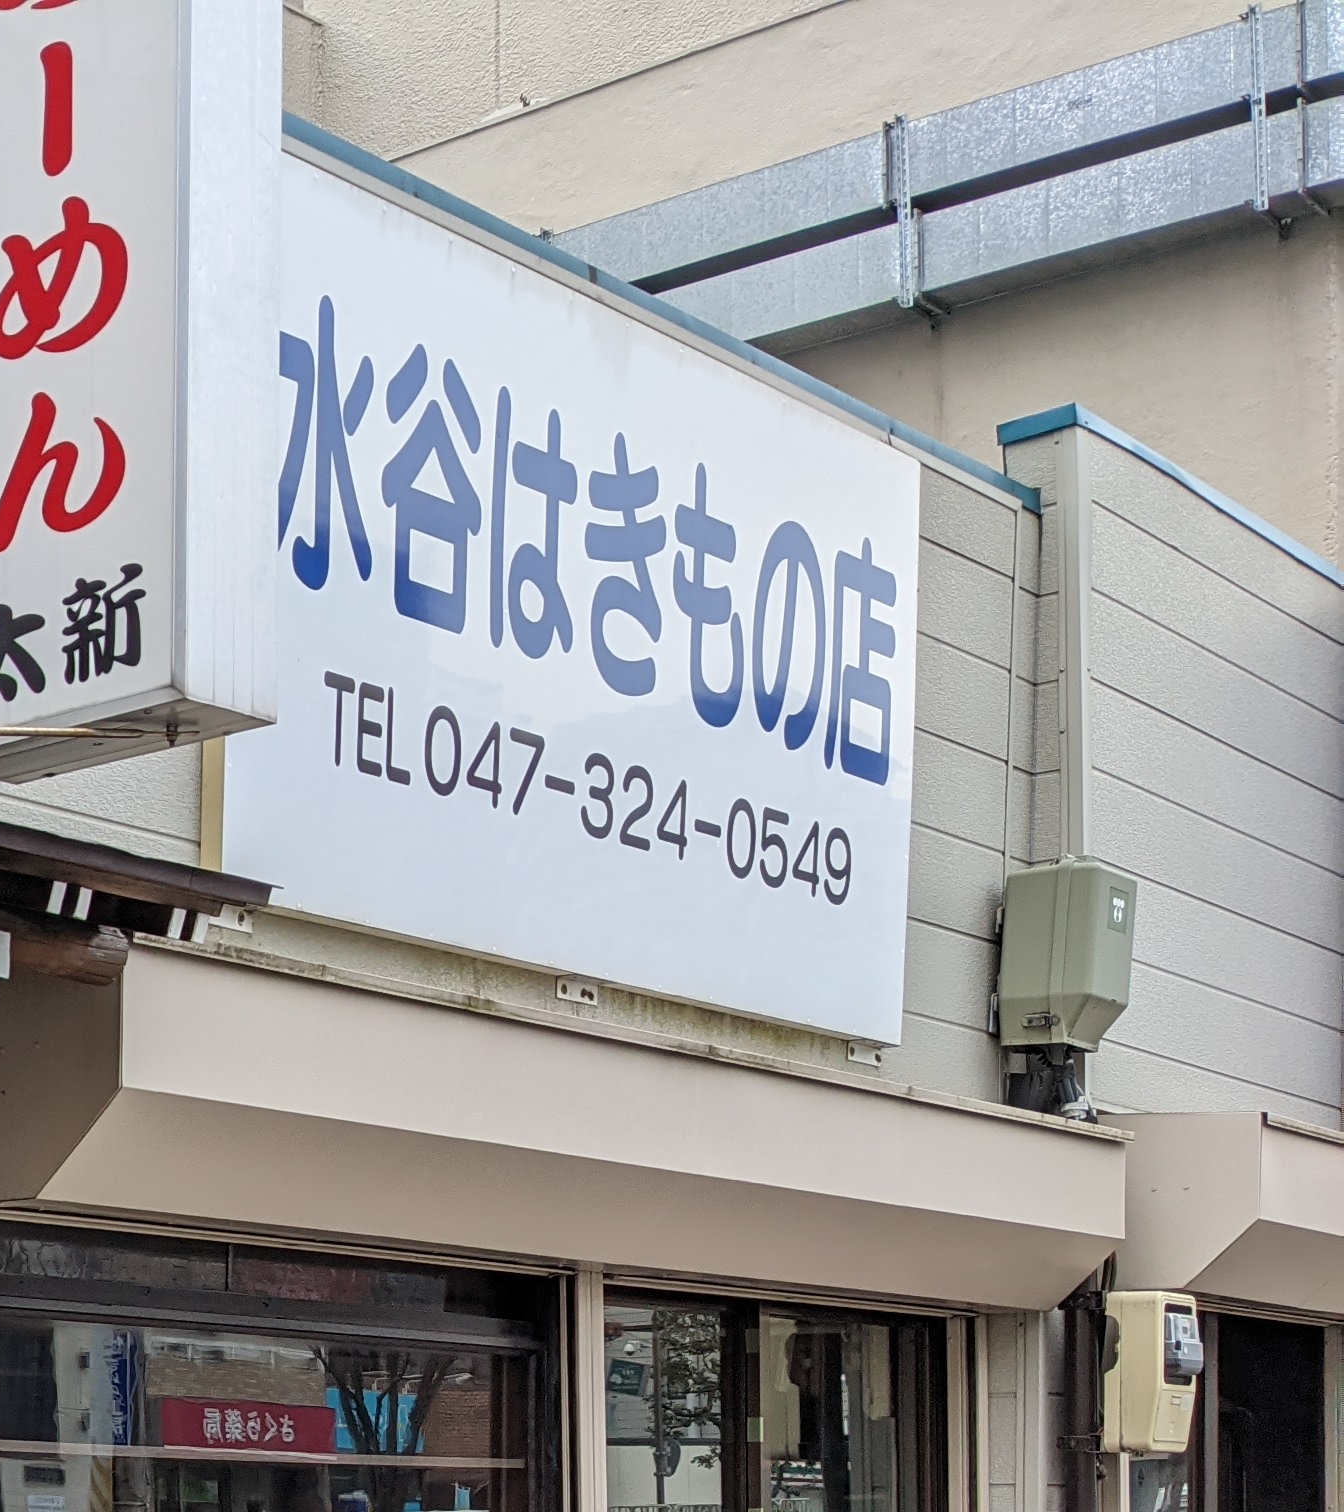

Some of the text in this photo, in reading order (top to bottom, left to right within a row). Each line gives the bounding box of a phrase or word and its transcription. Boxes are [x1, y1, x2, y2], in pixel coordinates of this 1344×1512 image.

[278, 294, 898, 787] 水谷はきもの店
[323, 671, 853, 906] TEL 047-324-0549
